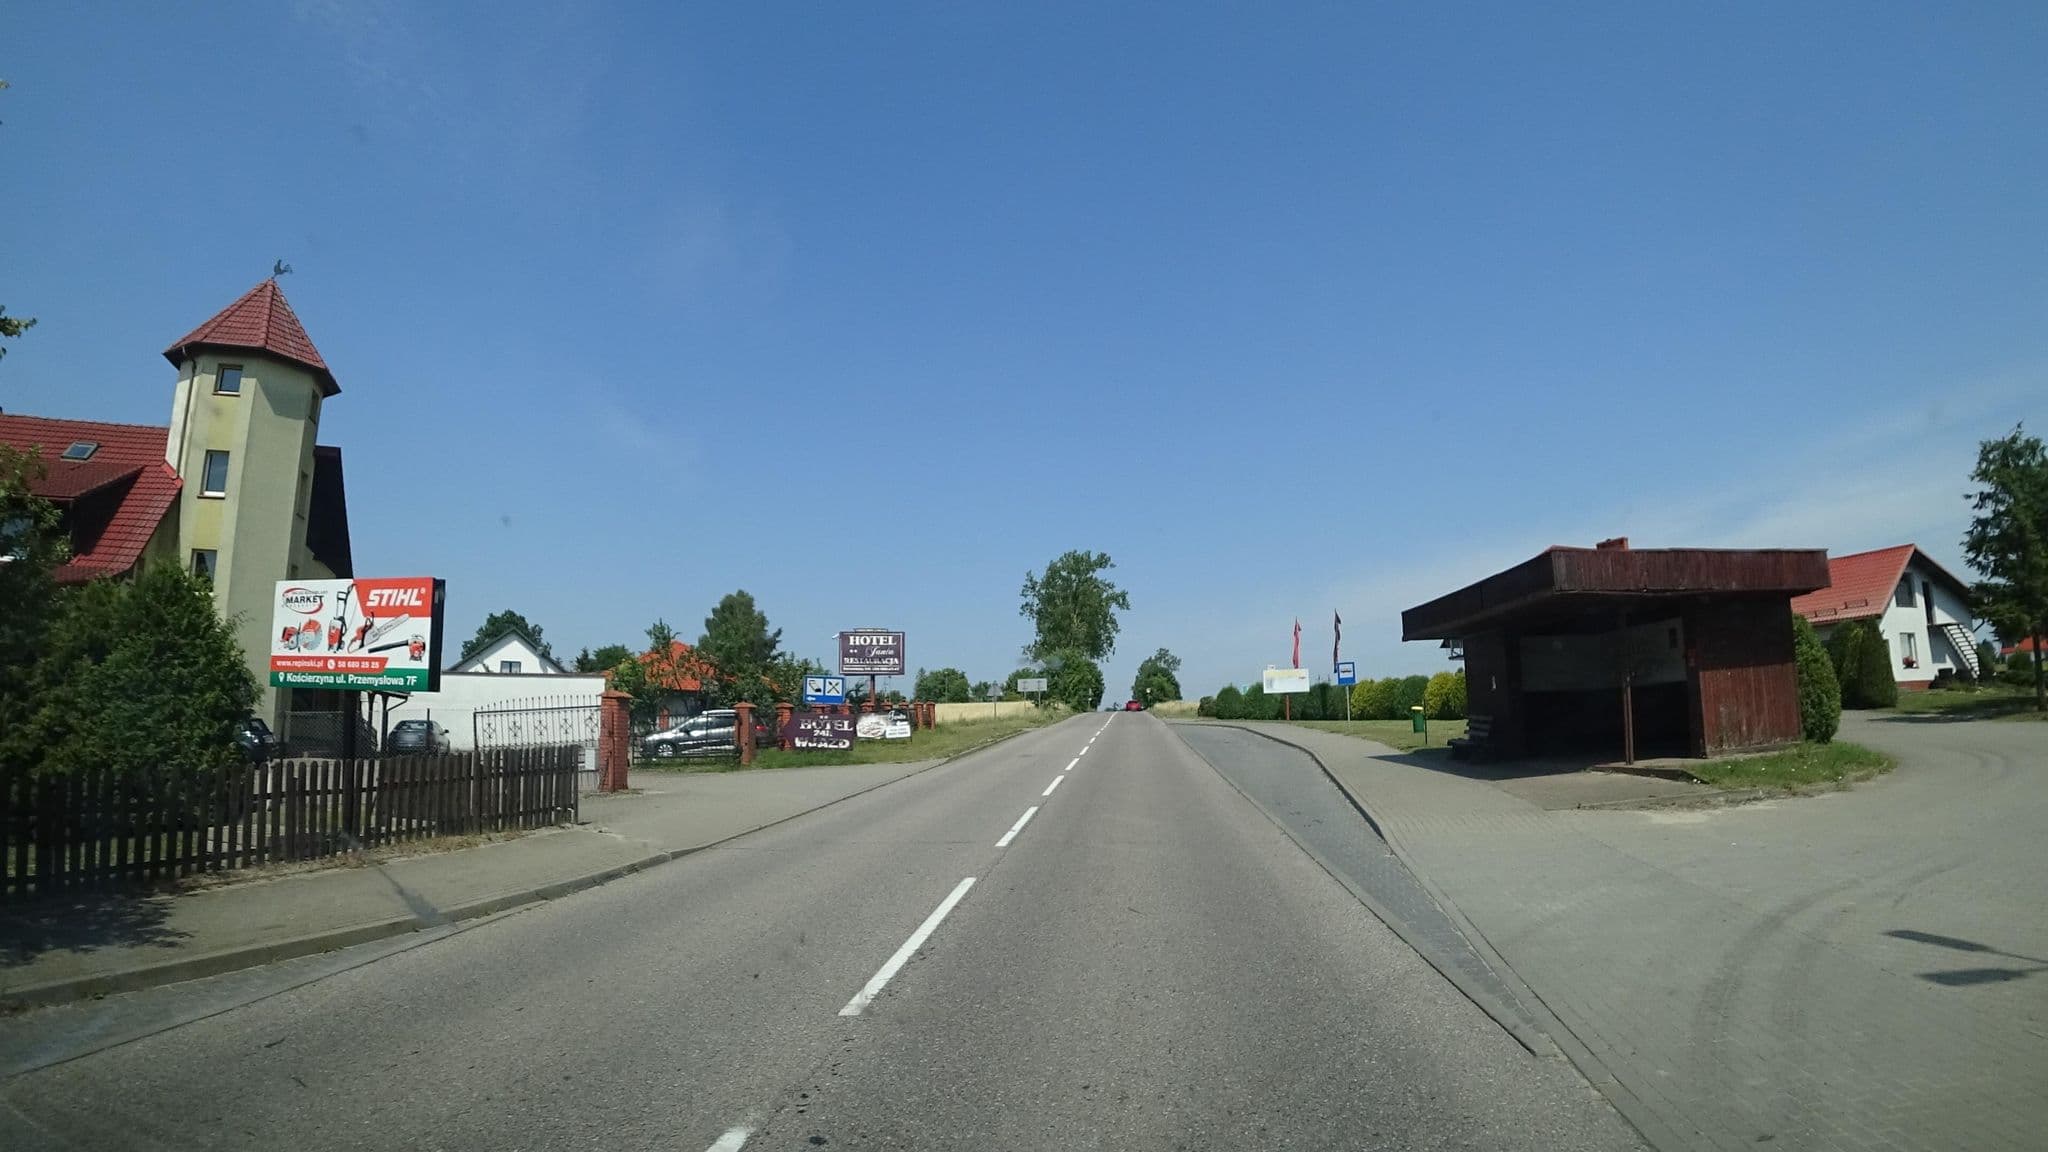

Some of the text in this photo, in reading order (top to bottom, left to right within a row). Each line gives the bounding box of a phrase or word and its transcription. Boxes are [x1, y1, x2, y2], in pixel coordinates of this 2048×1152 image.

[286, 595, 325, 604] MARKET
[366, 588, 423, 607] STIHL
[849, 635, 897, 646] HOTEL
[336, 674, 347, 684] ul.
[406, 676, 418, 686] 7F
[799, 719, 854, 731] HOTEL
[795, 736, 850, 749] WJAZD
